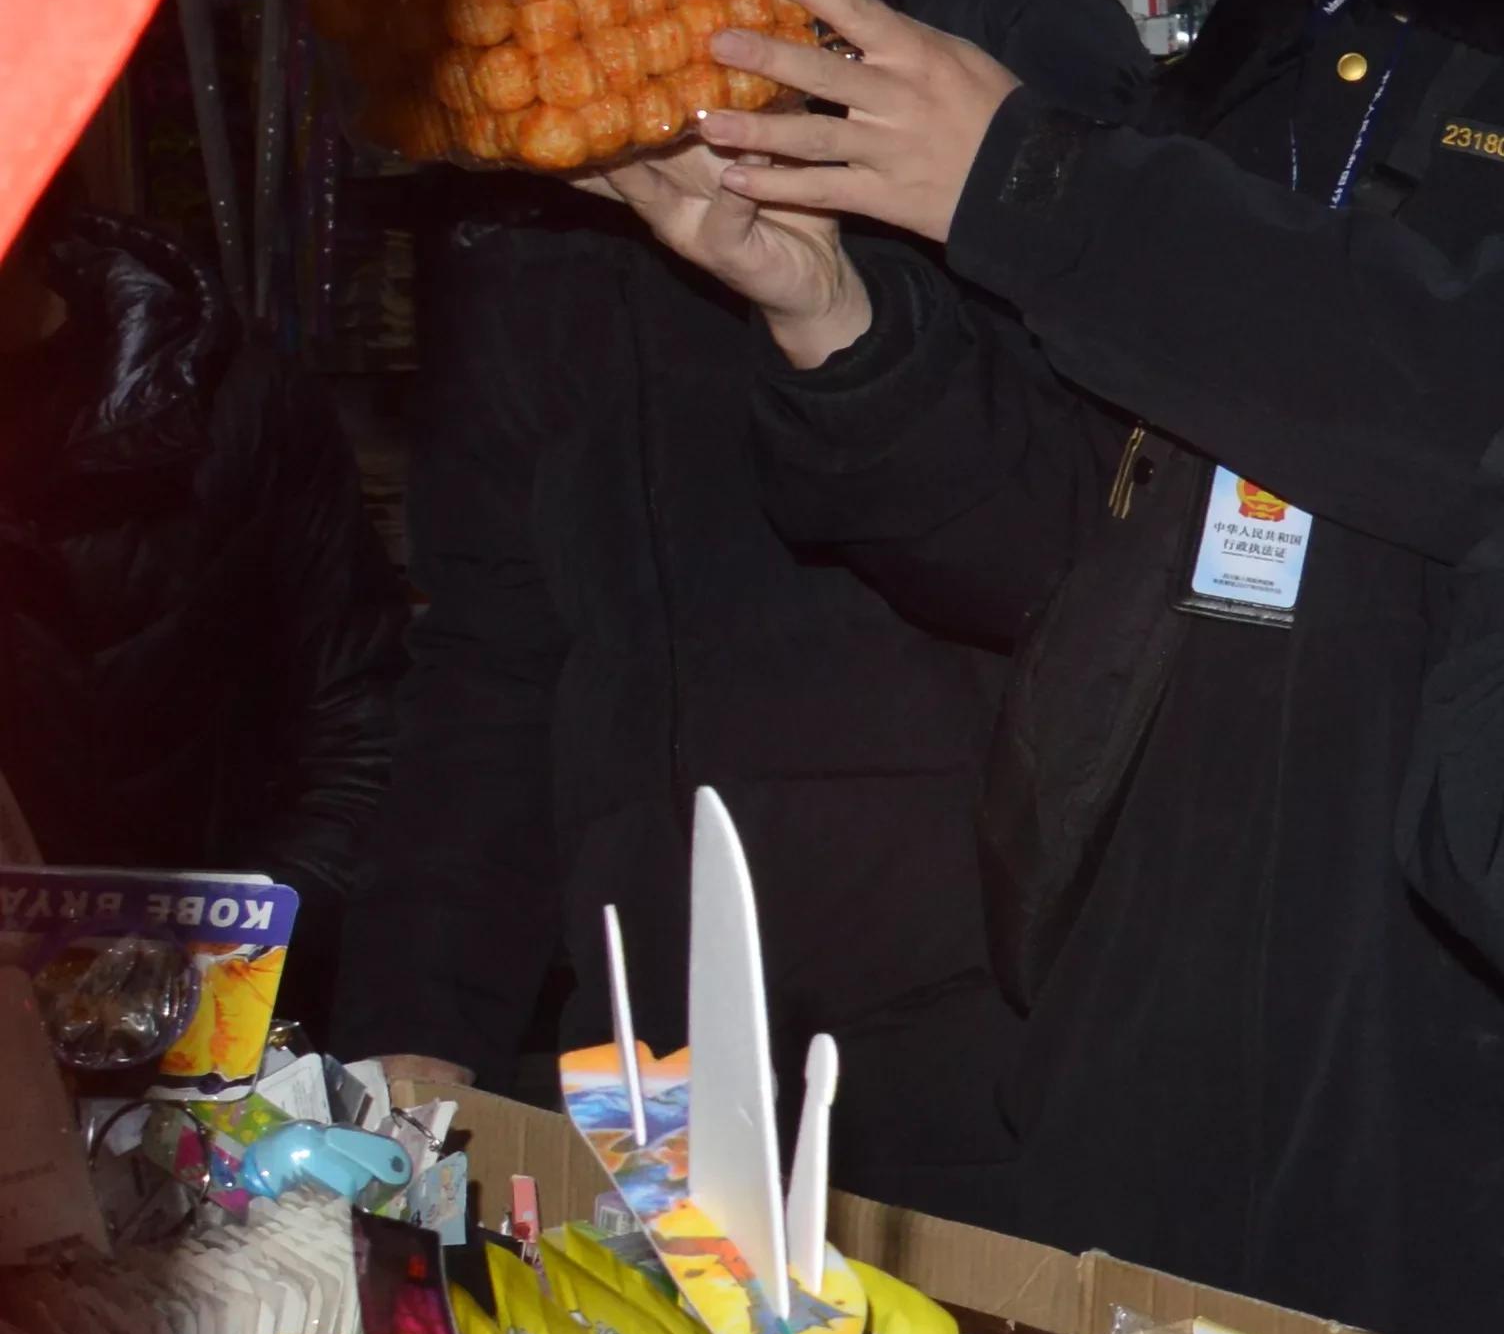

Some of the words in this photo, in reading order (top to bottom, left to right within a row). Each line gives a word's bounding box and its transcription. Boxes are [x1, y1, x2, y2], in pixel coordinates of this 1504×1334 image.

[1213, 522, 1303, 546] 中华人民共和国
[1222, 537, 1286, 560] 行政执法证
[147, 896, 274, 930] KOBE
